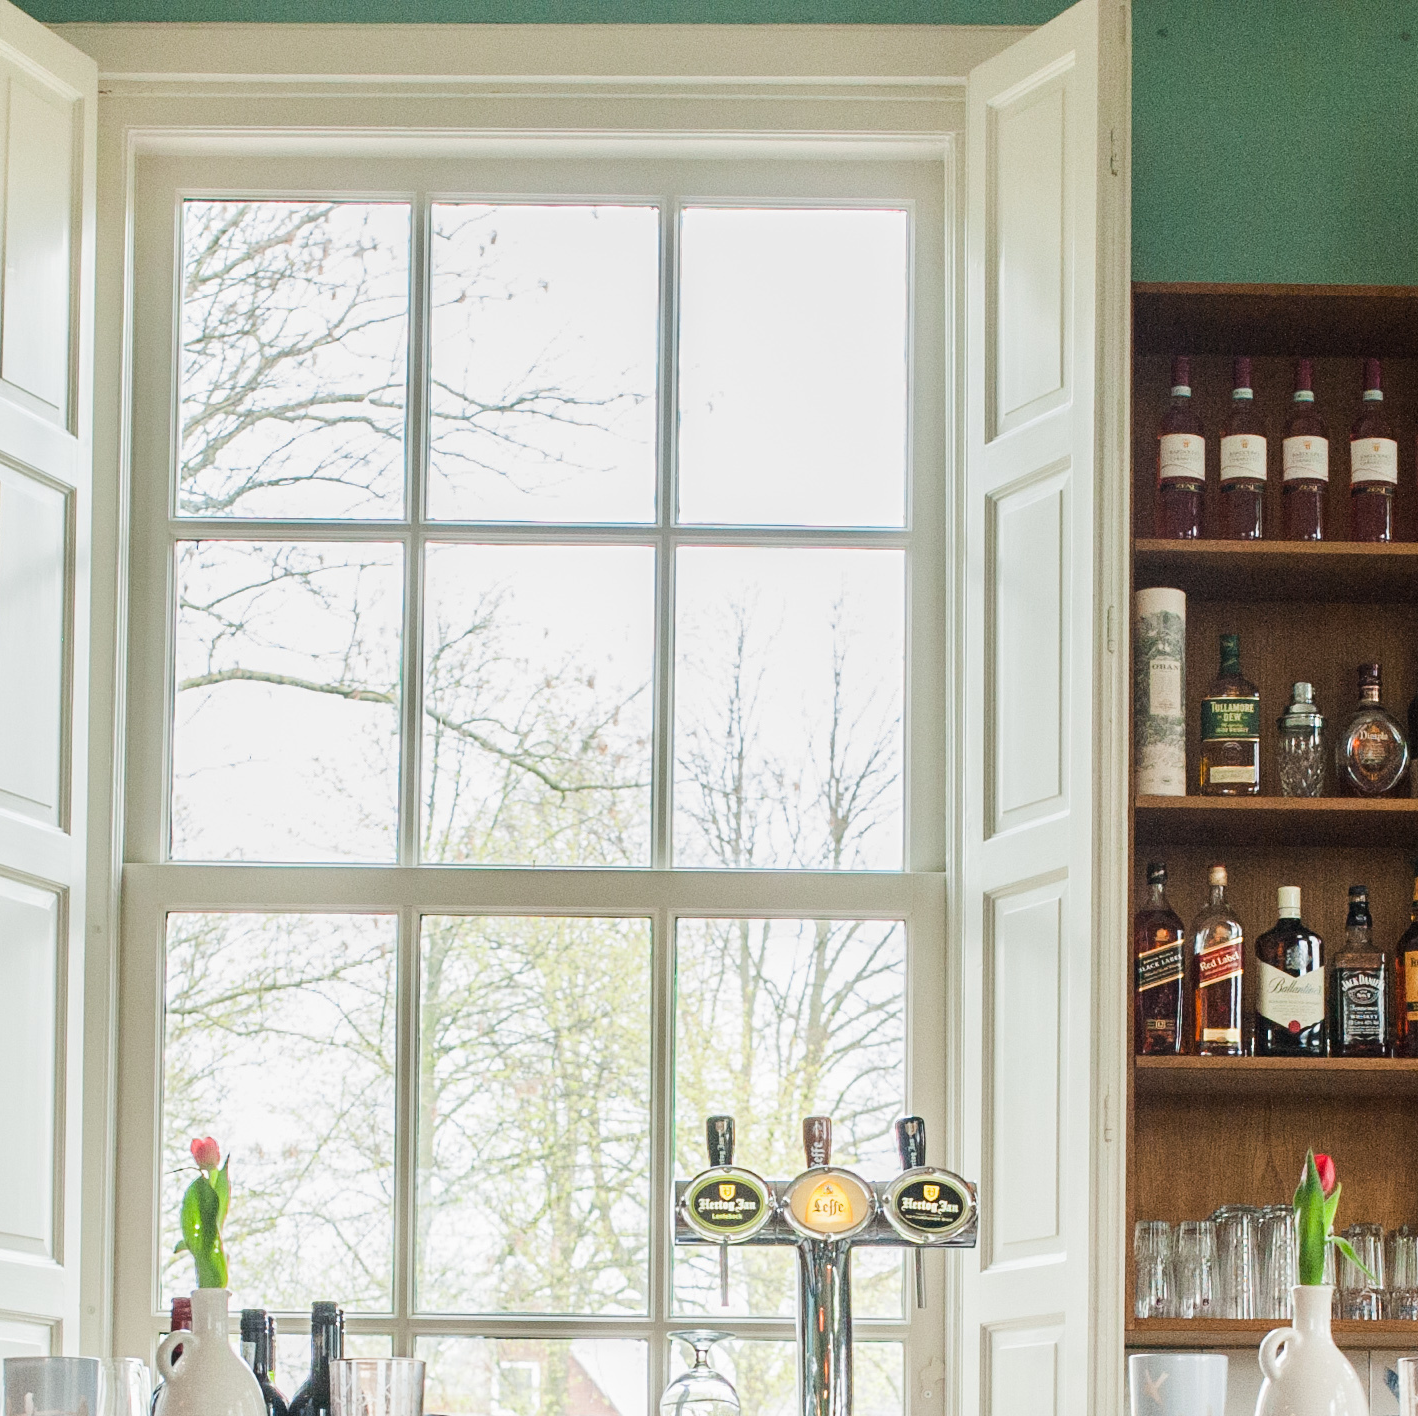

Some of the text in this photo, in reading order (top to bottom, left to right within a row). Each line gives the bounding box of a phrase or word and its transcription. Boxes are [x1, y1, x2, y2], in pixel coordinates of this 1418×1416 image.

[1211, 701, 1255, 713] TULLAMORE
[1223, 713, 1242, 721] DEW
[1200, 951, 1240, 970] Red Label
[698, 1198, 756, 1212] Hertog Jan
[813, 1199, 844, 1216] Leffe
[901, 1197, 959, 1214] Hertog Jan
